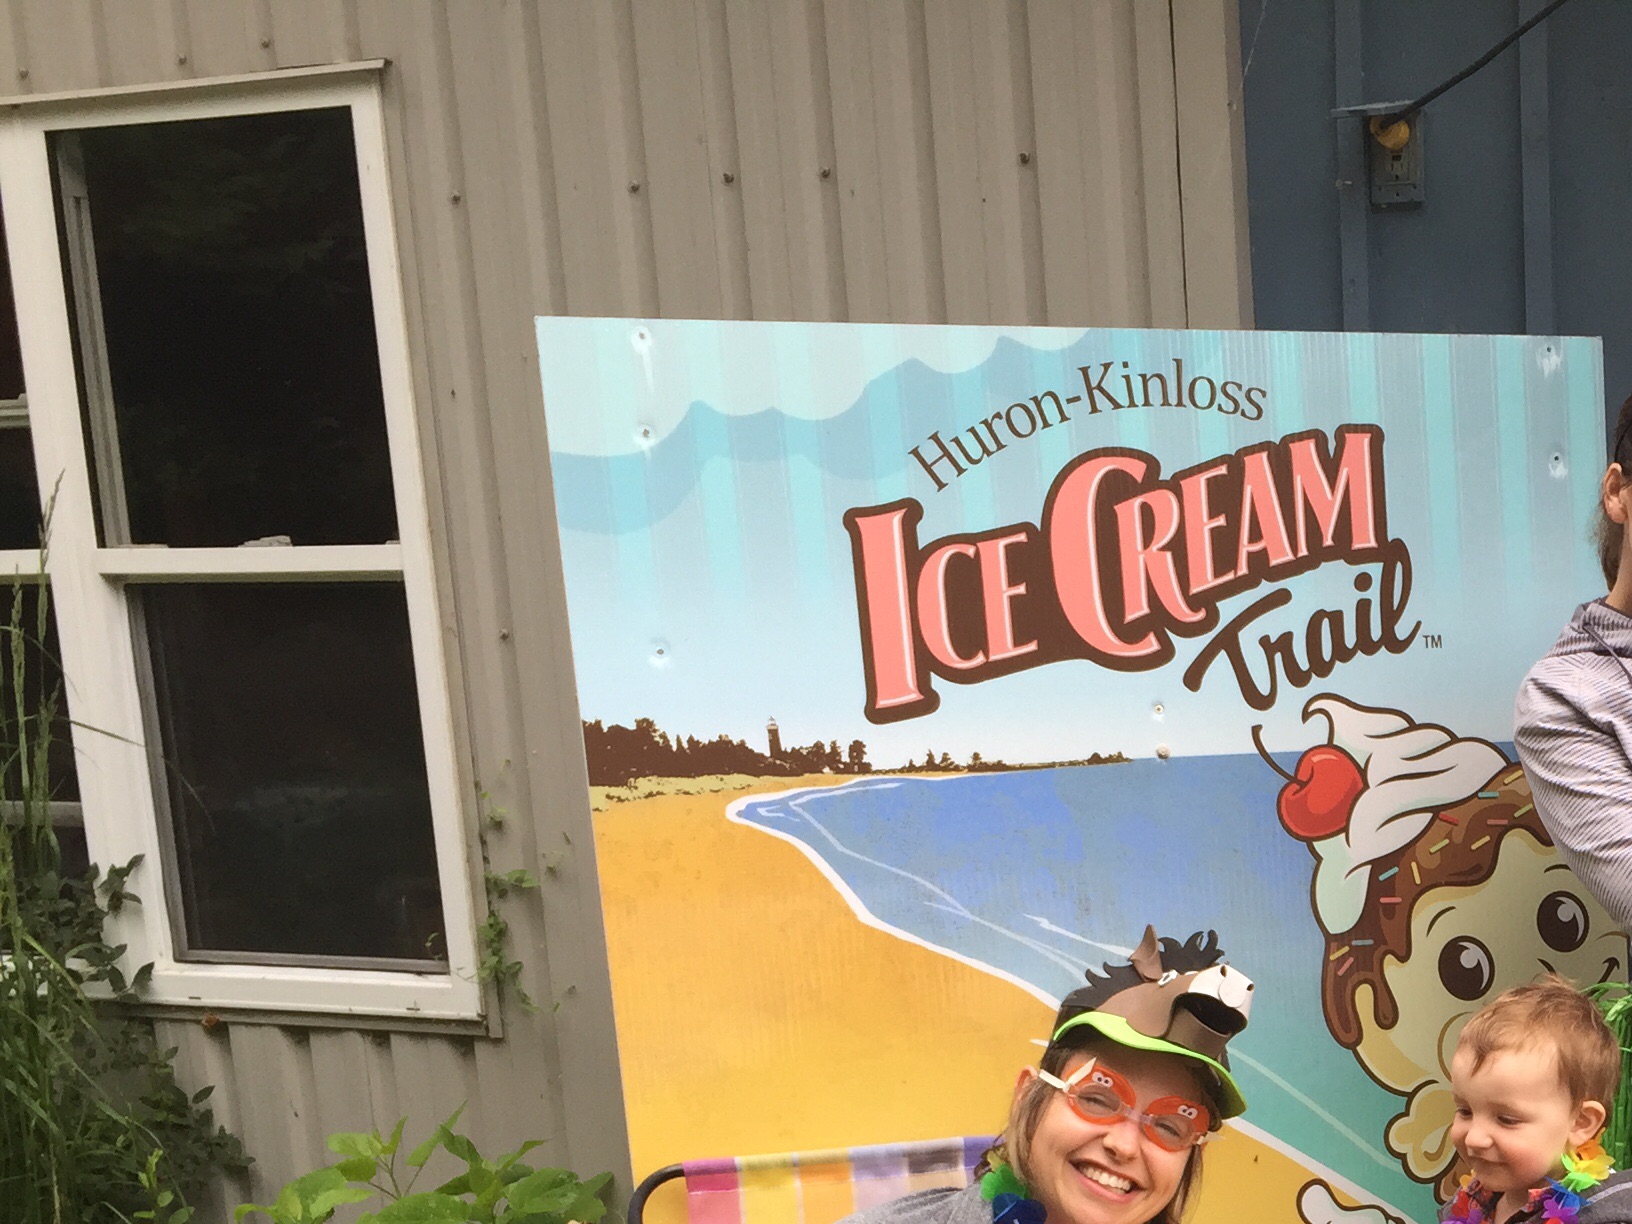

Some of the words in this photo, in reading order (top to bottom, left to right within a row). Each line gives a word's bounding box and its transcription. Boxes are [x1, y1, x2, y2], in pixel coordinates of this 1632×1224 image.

[907, 358, 1268, 492] Huron-Kinloss
[850, 502, 1040, 716] ICE
[1046, 427, 1385, 660] CREAM
[1183, 538, 1422, 711] Trail
